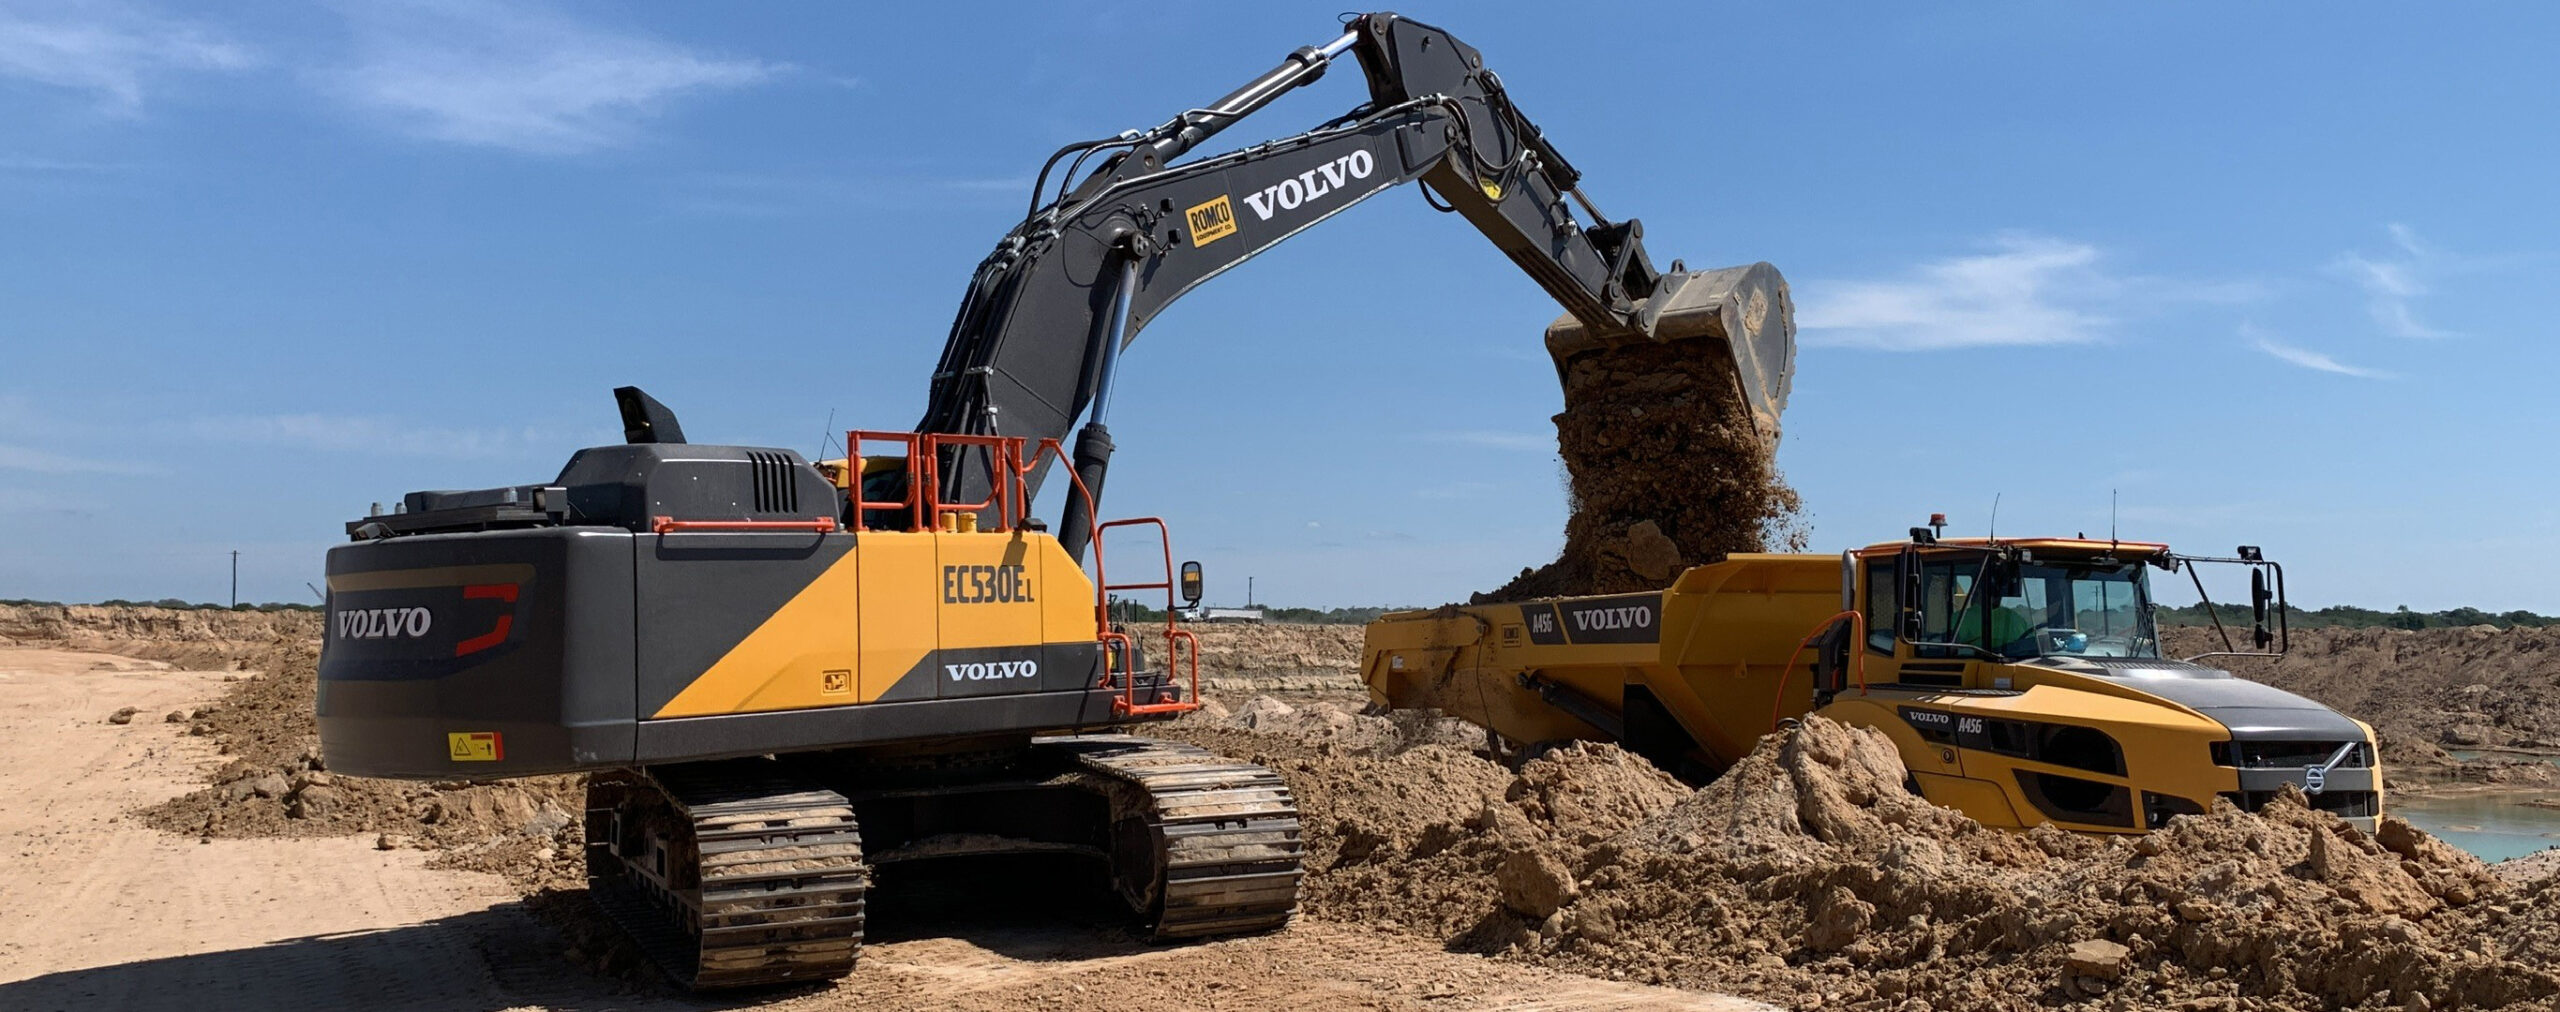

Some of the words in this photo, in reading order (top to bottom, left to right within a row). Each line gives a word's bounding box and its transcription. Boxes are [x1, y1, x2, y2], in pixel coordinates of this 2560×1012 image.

[1243, 149, 1374, 221] VOLVO
[1190, 201, 1230, 234] ROMCO
[338, 606, 432, 639] VOLVO
[1532, 612, 1553, 633] A45G
[1572, 605, 1652, 631] VOLVO
[944, 659, 1038, 681] VOLVO
[1908, 711, 1950, 724] VOLVO
[1958, 717, 1983, 734] A45G
